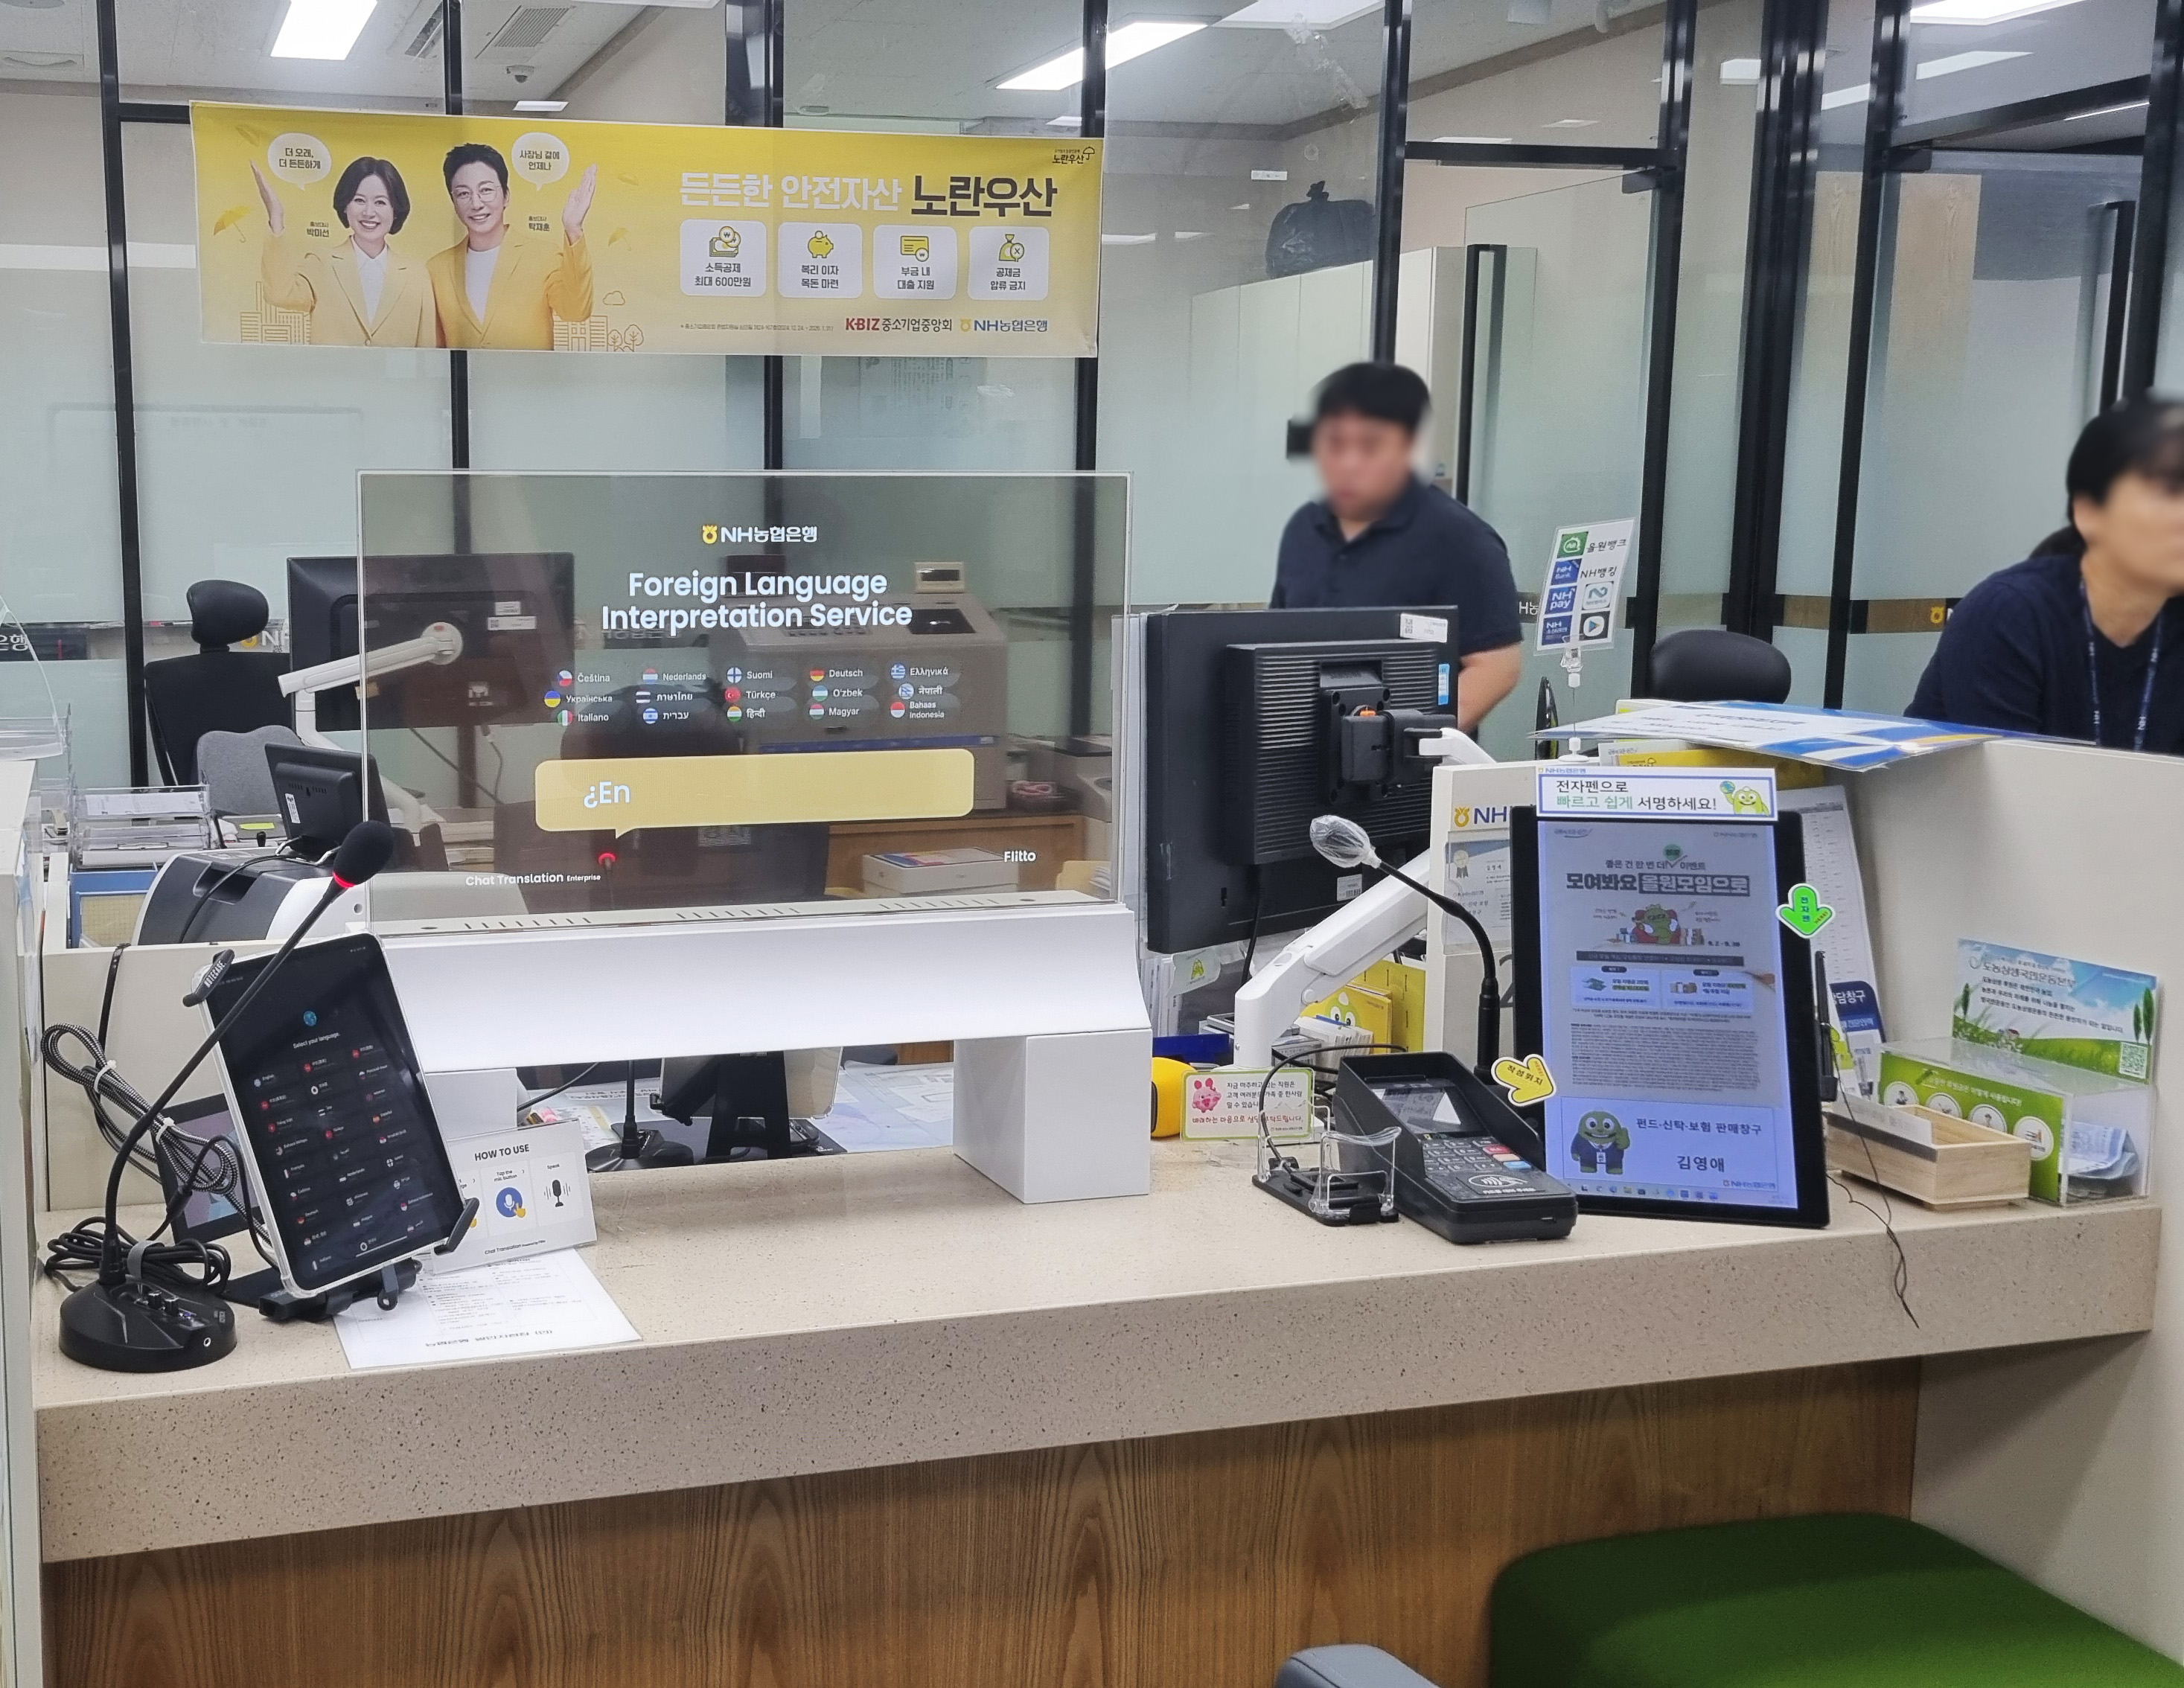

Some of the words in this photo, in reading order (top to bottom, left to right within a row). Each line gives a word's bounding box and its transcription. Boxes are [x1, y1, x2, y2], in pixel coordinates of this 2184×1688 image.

[285, 148, 293, 157] 더
[296, 149, 313, 159] 오래,
[520, 150, 543, 159] 사장님
[279, 159, 287, 167] 더
[289, 159, 321, 169] 든든하게
[1053, 155, 1084, 164] 노란우산
[529, 162, 552, 170] 언제나
[680, 171, 773, 207] 든든한
[782, 176, 902, 211] 안전자산
[911, 176, 1057, 217] 노란우산
[529, 223, 549, 231] 탁재훈
[307, 228, 329, 237] 박미선
[705, 263, 741, 273] 소득공제
[801, 265, 819, 275] 복리
[822, 266, 839, 275] 이자
[901, 266, 919, 276] 부금
[922, 266, 930, 276] 내
[996, 268, 1021, 278] 공제금
[695, 276, 712, 287] 최대
[715, 277, 751, 287] 600만원
[801, 278, 819, 289] 목돈
[822, 279, 839, 289] 마련
[897, 280, 915, 290] 대출
[917, 280, 934, 290] 지원
[990, 281, 1007, 290] 압류
[1009, 281, 1026, 290] 금지
[882, 319, 952, 333] 중소기업중앙회
[974, 319, 1048, 333] NH농협은행
[721, 526, 817, 543] NH농협은행
[1586, 539, 1626, 553] 올원뱅크
[1580, 566, 1617, 578] NH뱅킹
[629, 569, 737, 604] Foreign
[745, 572, 887, 602] Language
[1552, 591, 1572, 601] NH
[1550, 600, 1571, 610] pay
[602, 601, 802, 637] Interpretation
[810, 600, 913, 627] Service
[747, 671, 773, 680] Suomi
[828, 669, 863, 678] Deutsch
[910, 666, 948, 677] Ελληνικά
[577, 674, 610, 682] Čeština
[662, 673, 706, 681] Nederlands
[918, 685, 943, 696] नेपाली
[566, 694, 613, 704] Українська
[656, 691, 693, 702] ภาษาไทย
[746, 691, 776, 701] Türkçe
[578, 713, 609, 722] Italiano
[662, 712, 689, 720] עברית
[746, 708, 766, 718] हिन्दी
[828, 708, 860, 717] Magyar
[1556, 780, 1628, 793] 전자펜으로
[584, 781, 630, 808] ¿En
[1556, 796, 1600, 809] 빠르고
[1604, 796, 1632, 810] 쉽게
[1638, 797, 1717, 811] 서명하세요!
[1474, 806, 1507, 825] NH
[1004, 850, 1036, 863] Flitto
[1680, 862, 1706, 870] 이벤트
[466, 876, 494, 886] Chat
[497, 873, 563, 885] Translation
[566, 875, 601, 883] Enterprise
[1566, 873, 1638, 891] 모여봐요
[1641, 875, 1749, 894] 올원모임으로
[1833, 990, 1865, 1005] 담창구
[1221, 1116, 1245, 1124] 마음으로
[1715, 1122, 1762, 1136] 판매창구
[474, 1149, 497, 1161] HOW
[499, 1147, 511, 1157] TO
[512, 1144, 530, 1154] USE
[1677, 1155, 1725, 1173] 김영애
